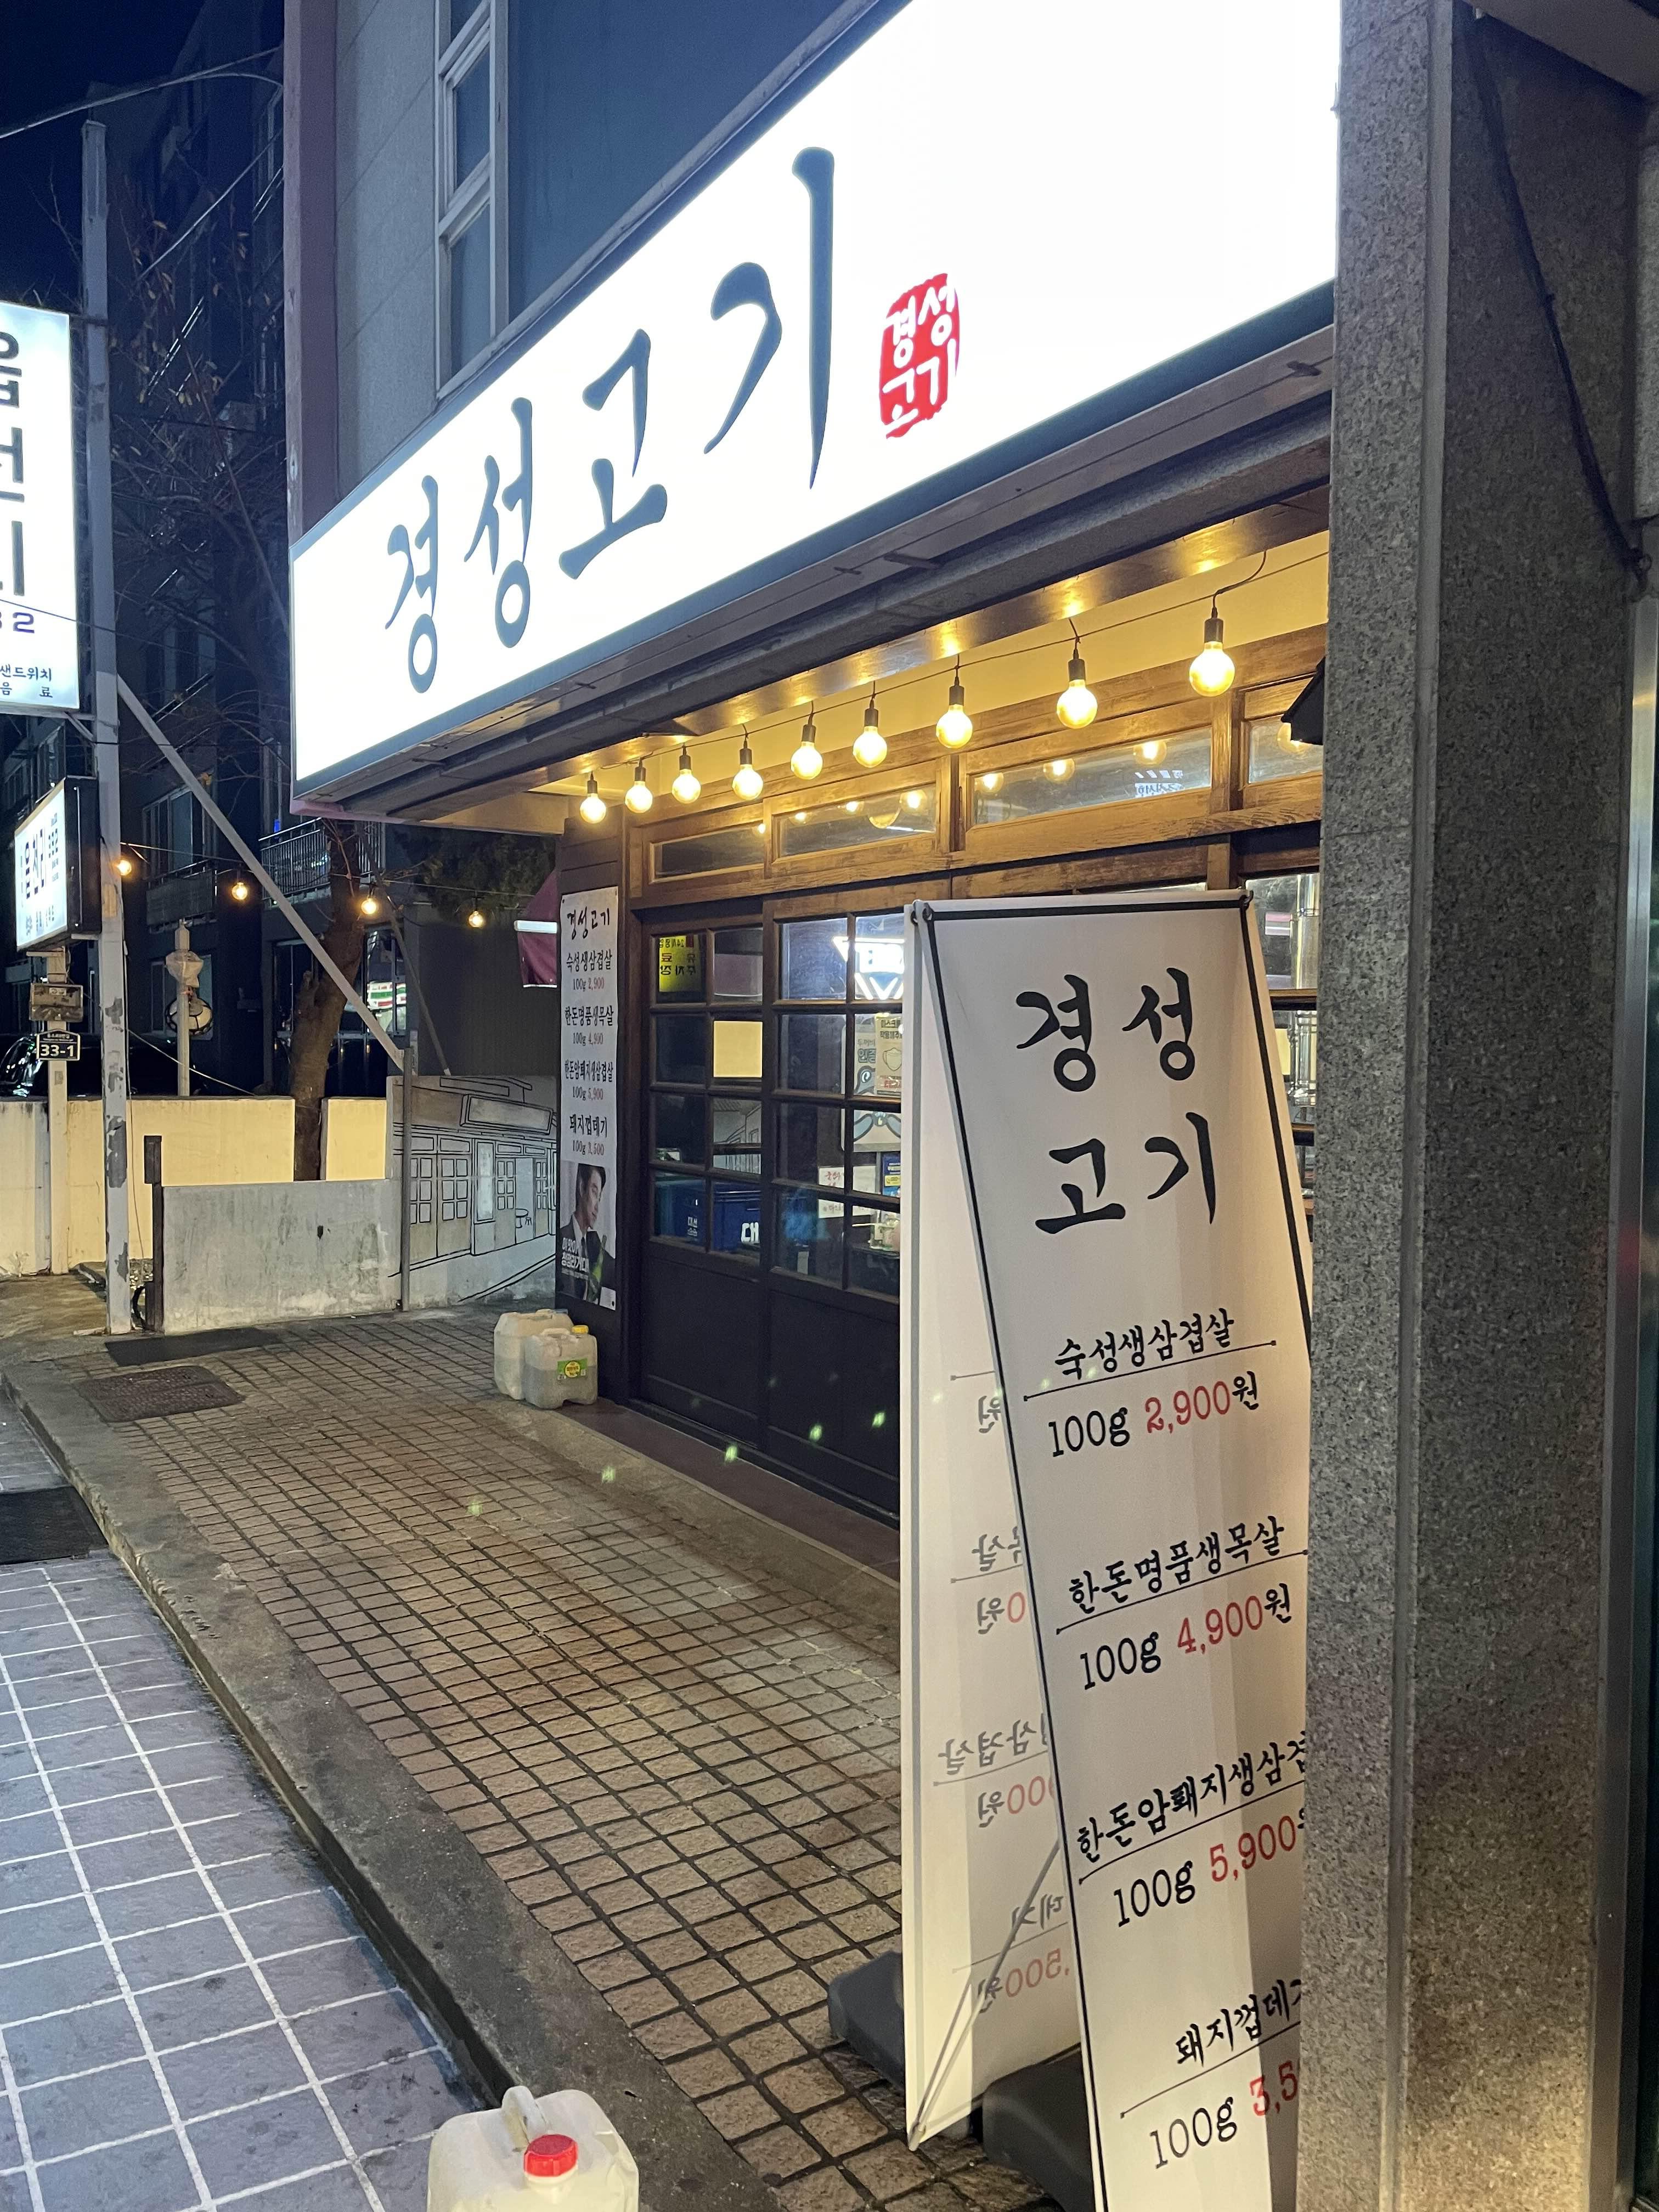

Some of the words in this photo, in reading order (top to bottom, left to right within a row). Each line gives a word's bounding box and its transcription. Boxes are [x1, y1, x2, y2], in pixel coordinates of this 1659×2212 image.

[881, 286, 956, 369] 경성
[386, 146, 835, 693] 경성고기
[879, 338, 957, 435] 고기
[0, 664, 52, 682] 샌드위치
[567, 906, 610, 940] 경성고기
[566, 949, 612, 973] 숙성생삼겹살
[573, 978, 586, 992] 100g
[588, 977, 604, 991] 2,900
[40, 1044, 74, 1057] 33-1
[573, 1032, 586, 1046] 100g
[1015, 967, 1195, 1092] 경성
[569, 1114, 608, 1138] 돼지껍데기
[572, 1086, 586, 1101] 100g
[572, 1139, 586, 1155] 100g
[1035, 1111, 1216, 1235] 고기
[1054, 1307, 1235, 1381] 숙성생삼겹살
[1048, 1407, 1131, 1458] 100g
[1144, 1370, 1260, 1434] 2,900원
[1069, 1515, 1285, 1615] 한돈명품생목살
[1080, 1630, 1162, 1690] 100g
[1177, 1582, 1293, 1655] 4,900원
[1114, 1859, 1197, 1928] 100g
[1149, 2096, 1238, 2170] 100g
